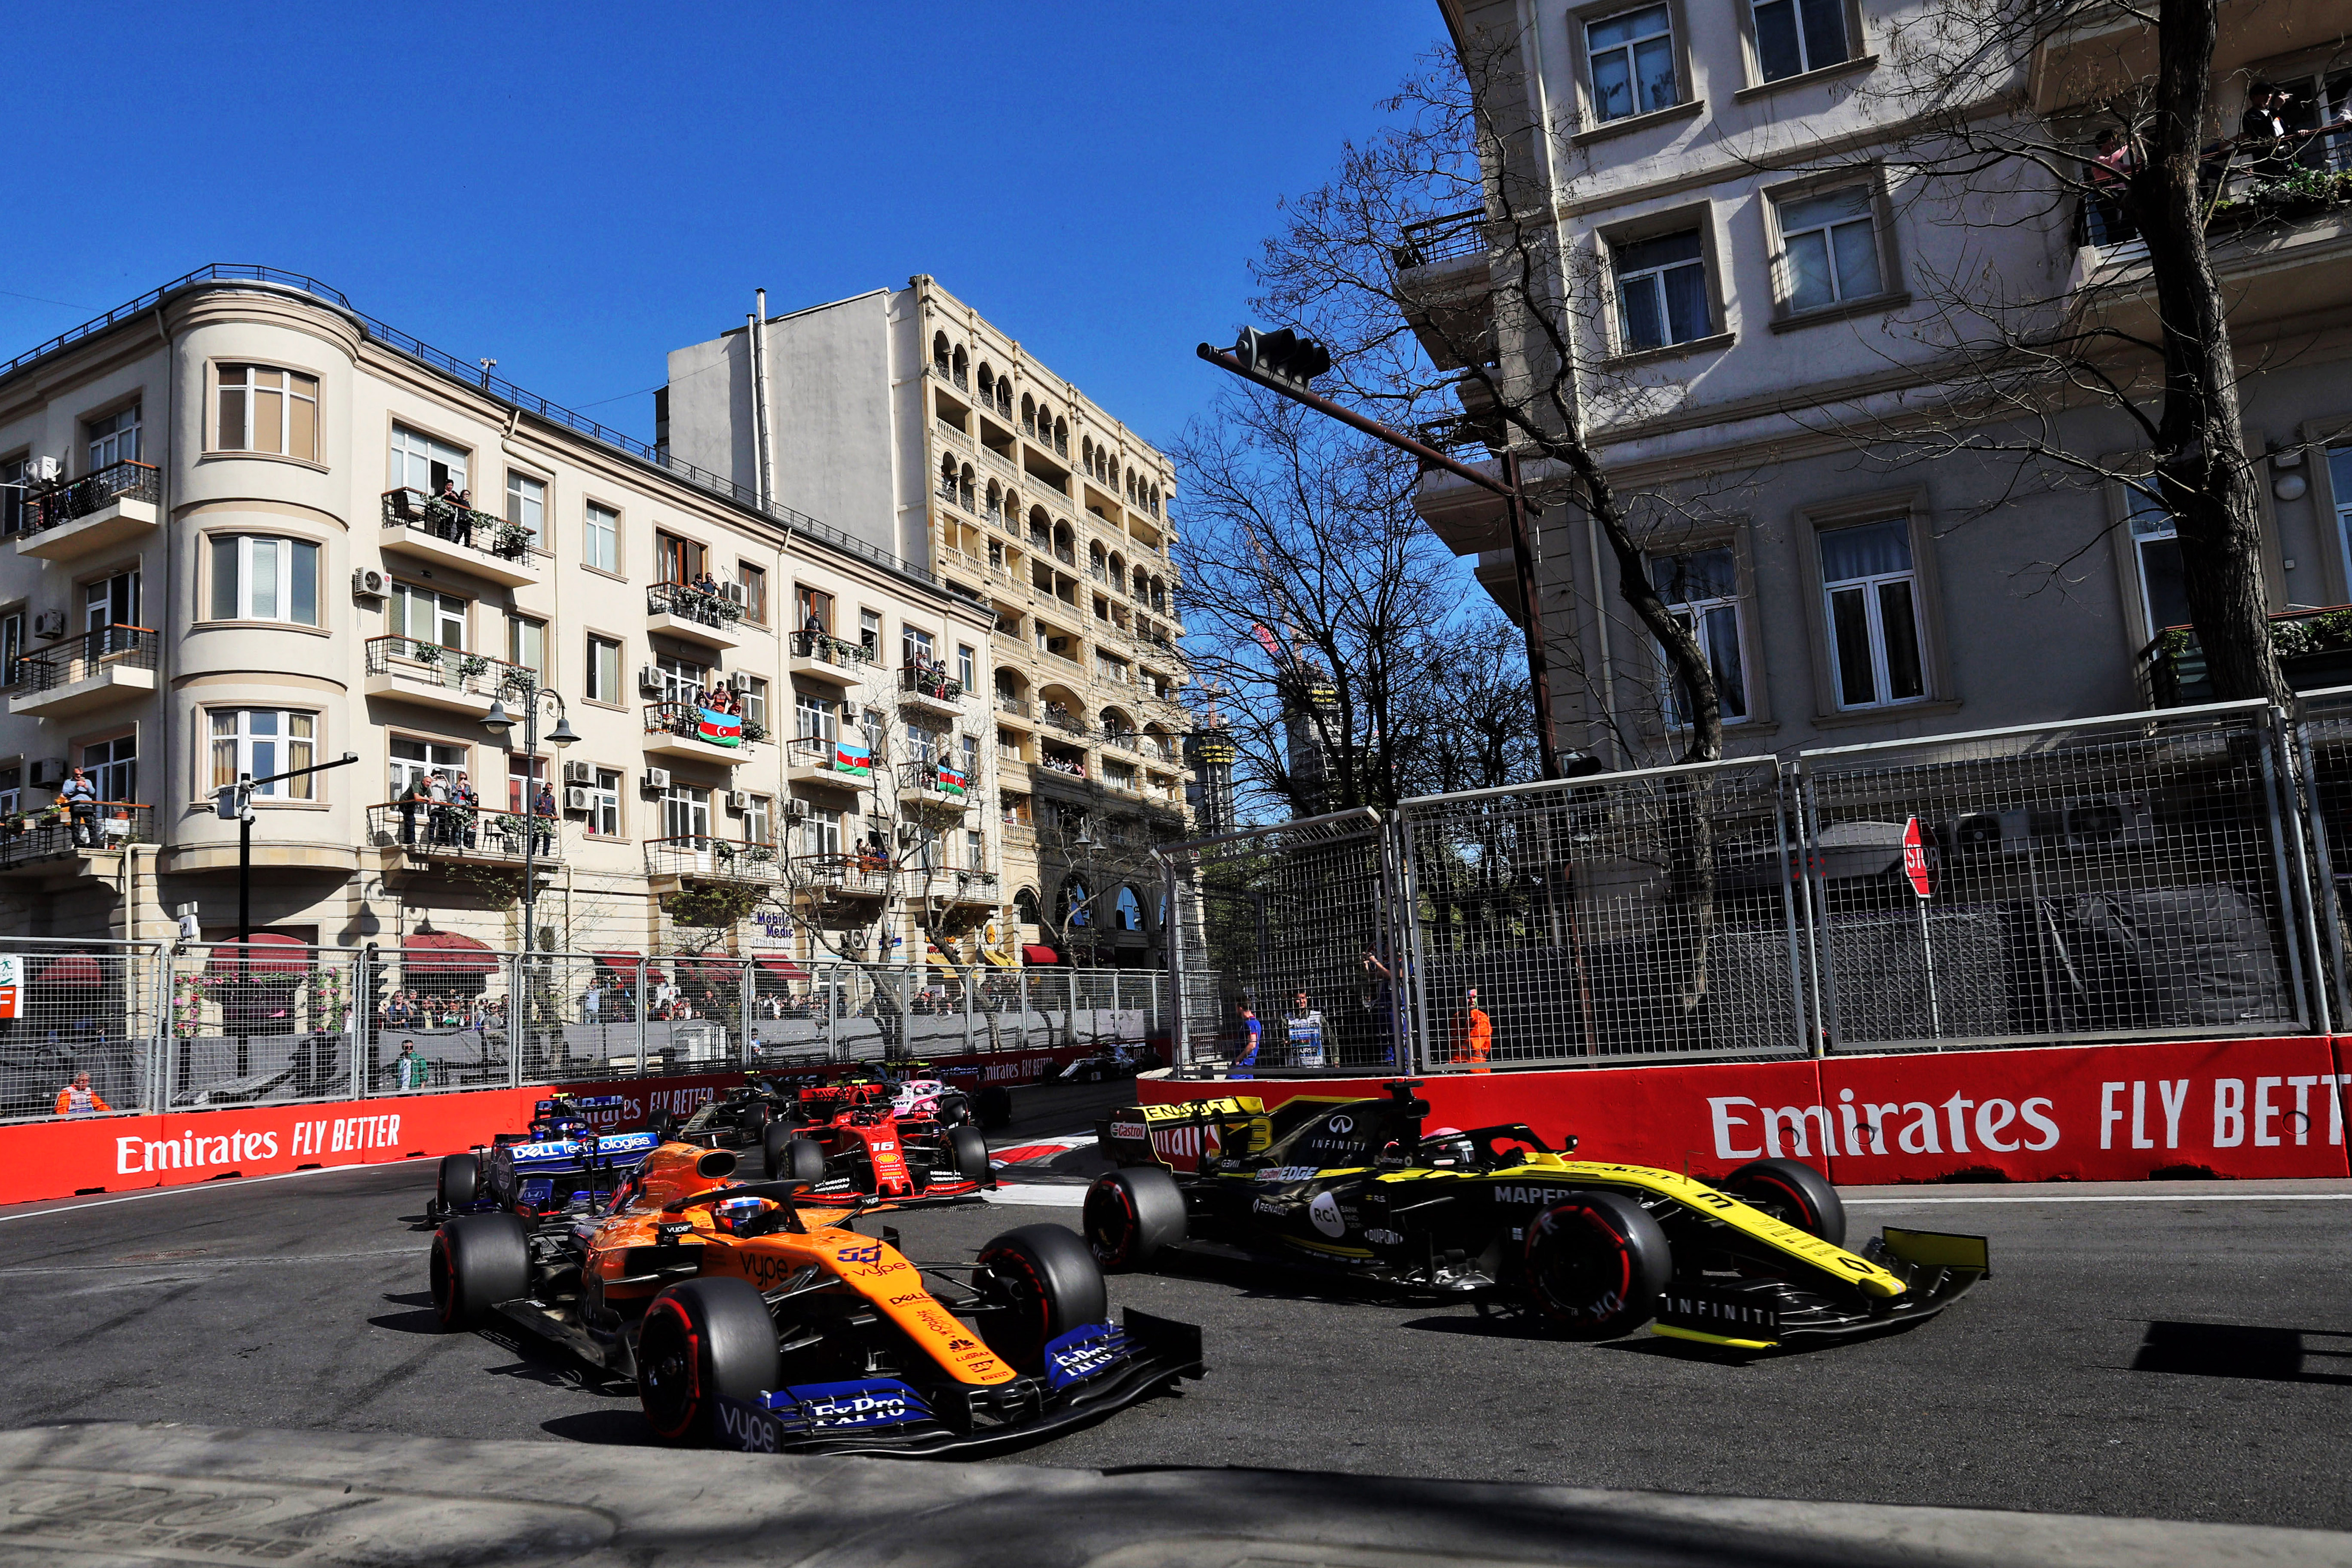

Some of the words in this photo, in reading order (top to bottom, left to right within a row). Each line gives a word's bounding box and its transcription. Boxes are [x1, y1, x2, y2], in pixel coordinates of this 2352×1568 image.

[1907, 843, 1938, 869] STOP
[757, 912, 790, 924] Mobile
[766, 925, 793, 937] Medic
[1706, 1088, 2060, 1159] Emirates
[2101, 1079, 2189, 1149] FLY
[2213, 1074, 2351, 1148] BETT
[1118, 1124, 1144, 1138] Castrol
[1248, 1116, 1273, 1153] 3
[116, 1129, 278, 1175] Emirates
[291, 1121, 327, 1156] FLY
[331, 1114, 400, 1152] BETTER
[870, 1141, 894, 1152] 16
[1312, 1139, 1366, 1151] INFINITI
[512, 1146, 560, 1159] DELL
[1279, 1167, 1319, 1181] EDGE
[1260, 1203, 1289, 1216] RENAULT
[1340, 1205, 1359, 1213] BANK
[836, 1244, 882, 1263] 55
[740, 1251, 788, 1287] vype
[851, 1262, 907, 1277] vype
[889, 1292, 931, 1305] DELL
[1666, 1297, 1775, 1326] INFINITI
[956, 1351, 991, 1362] LUBRAX
[969, 1361, 992, 1372] SAP
[719, 1403, 774, 1453] vype
